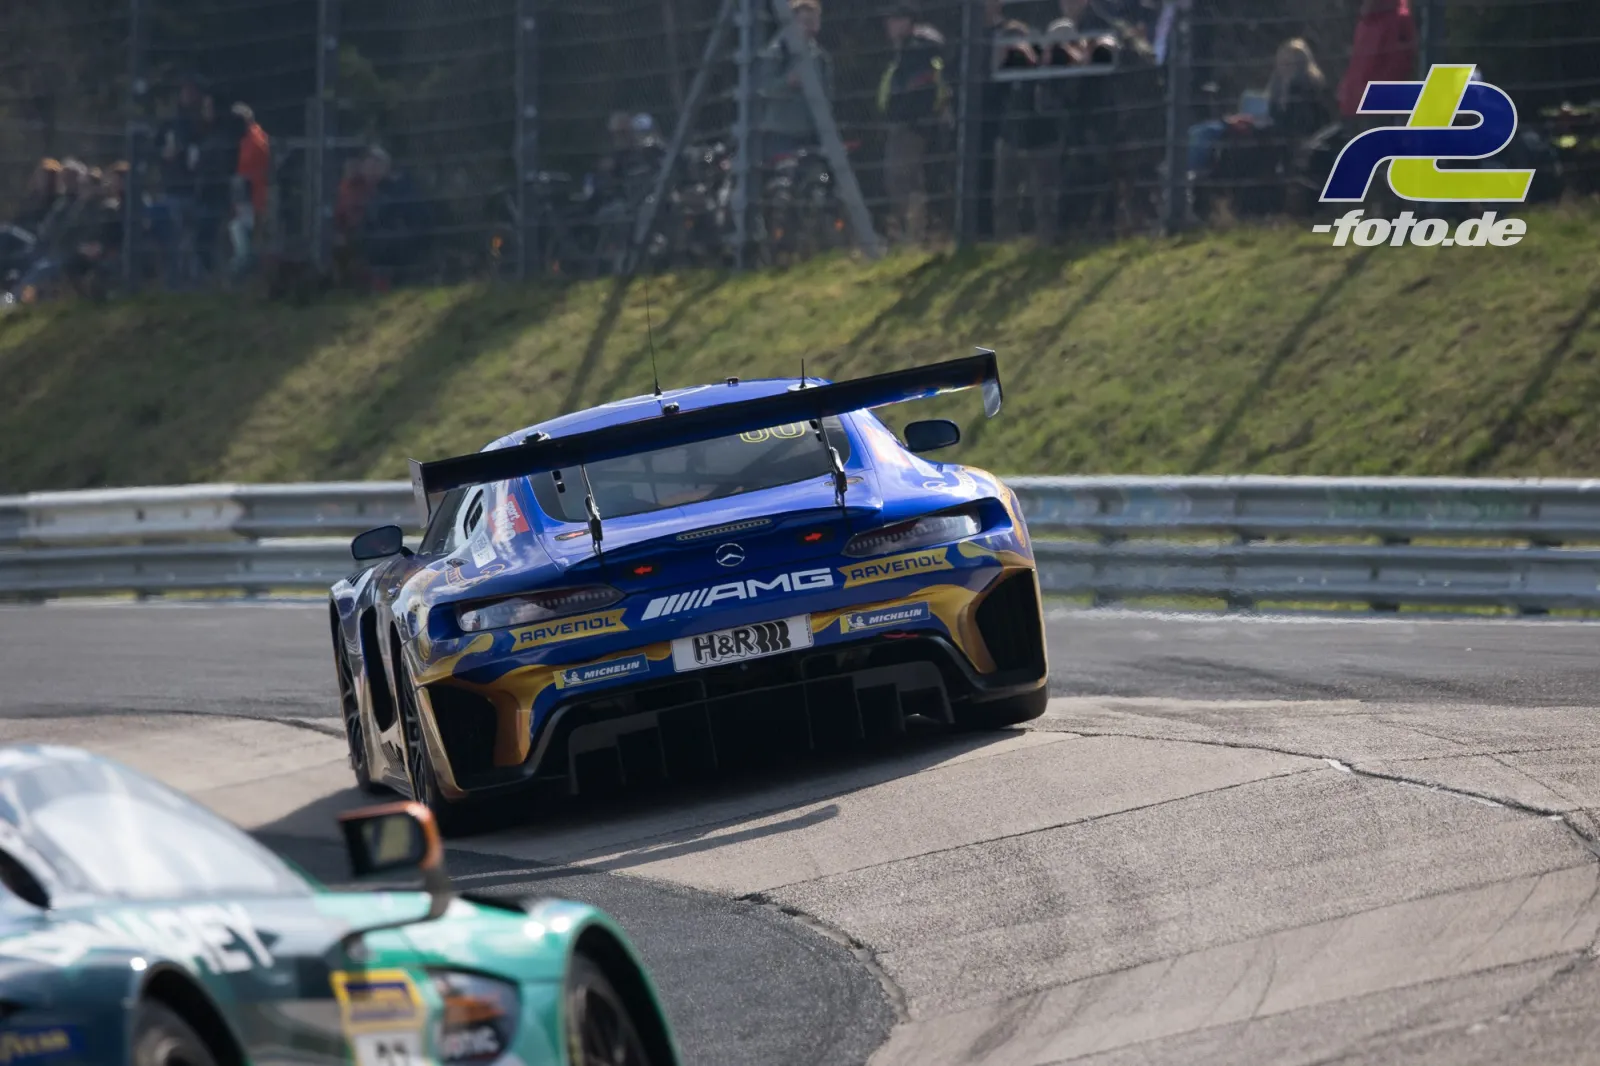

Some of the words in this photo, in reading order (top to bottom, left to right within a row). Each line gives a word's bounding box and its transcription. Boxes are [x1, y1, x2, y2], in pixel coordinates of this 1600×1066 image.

[851, 555, 943, 581] RAVENOL
[702, 567, 834, 609] AMG
[869, 609, 922, 623] MICHELIN
[519, 616, 617, 644] RAVENOL
[584, 660, 640, 679] MICHELIN
